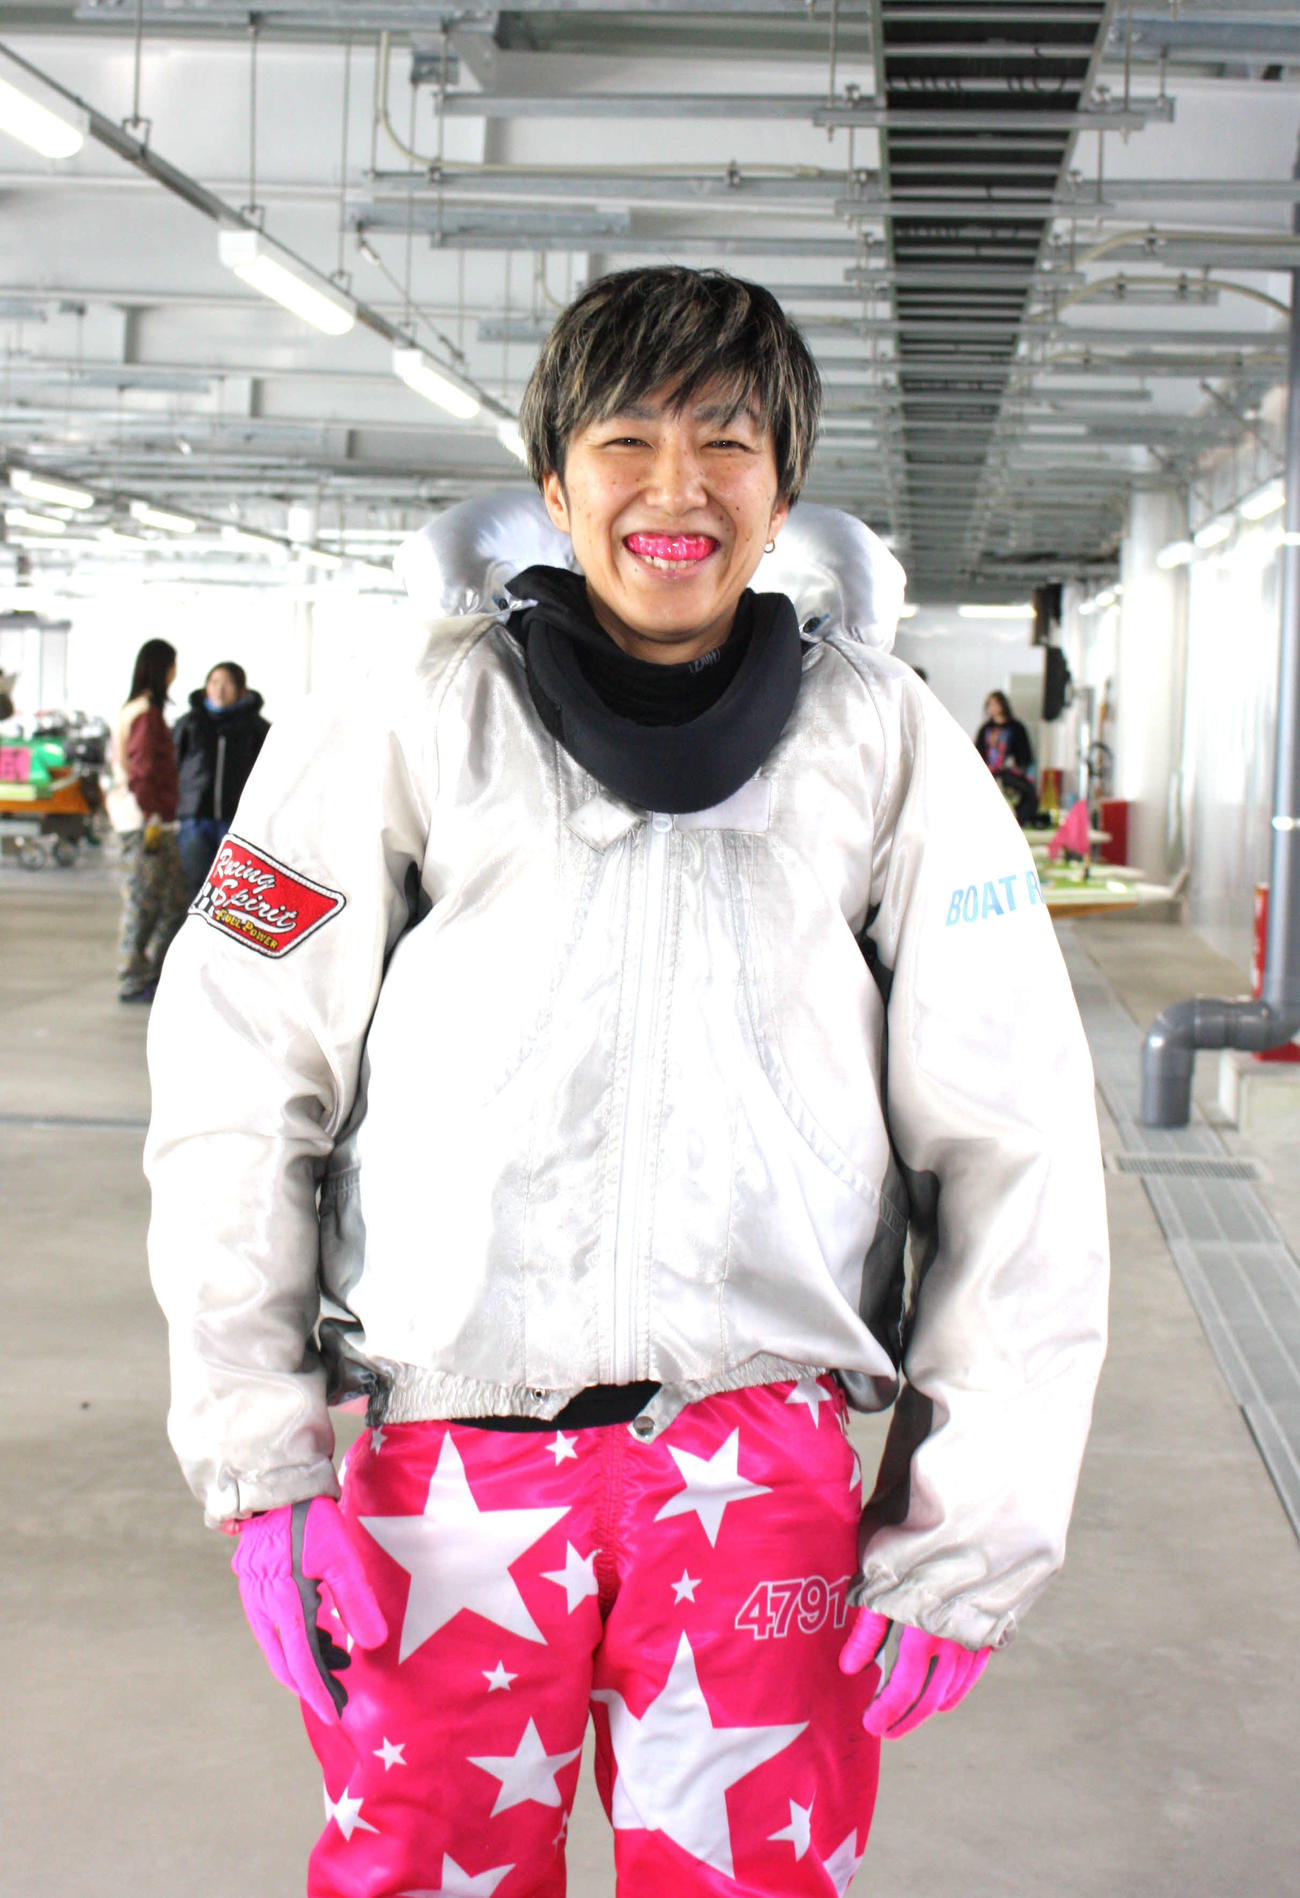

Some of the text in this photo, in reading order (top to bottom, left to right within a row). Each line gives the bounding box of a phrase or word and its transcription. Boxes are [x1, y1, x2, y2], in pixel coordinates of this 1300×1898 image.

[213, 848, 276, 894] Racing
[211, 878, 298, 931] Spirit
[945, 874, 1017, 927] BOAT
[216, 908, 278, 949] FULL POWER
[734, 1575, 851, 1640] 4791
